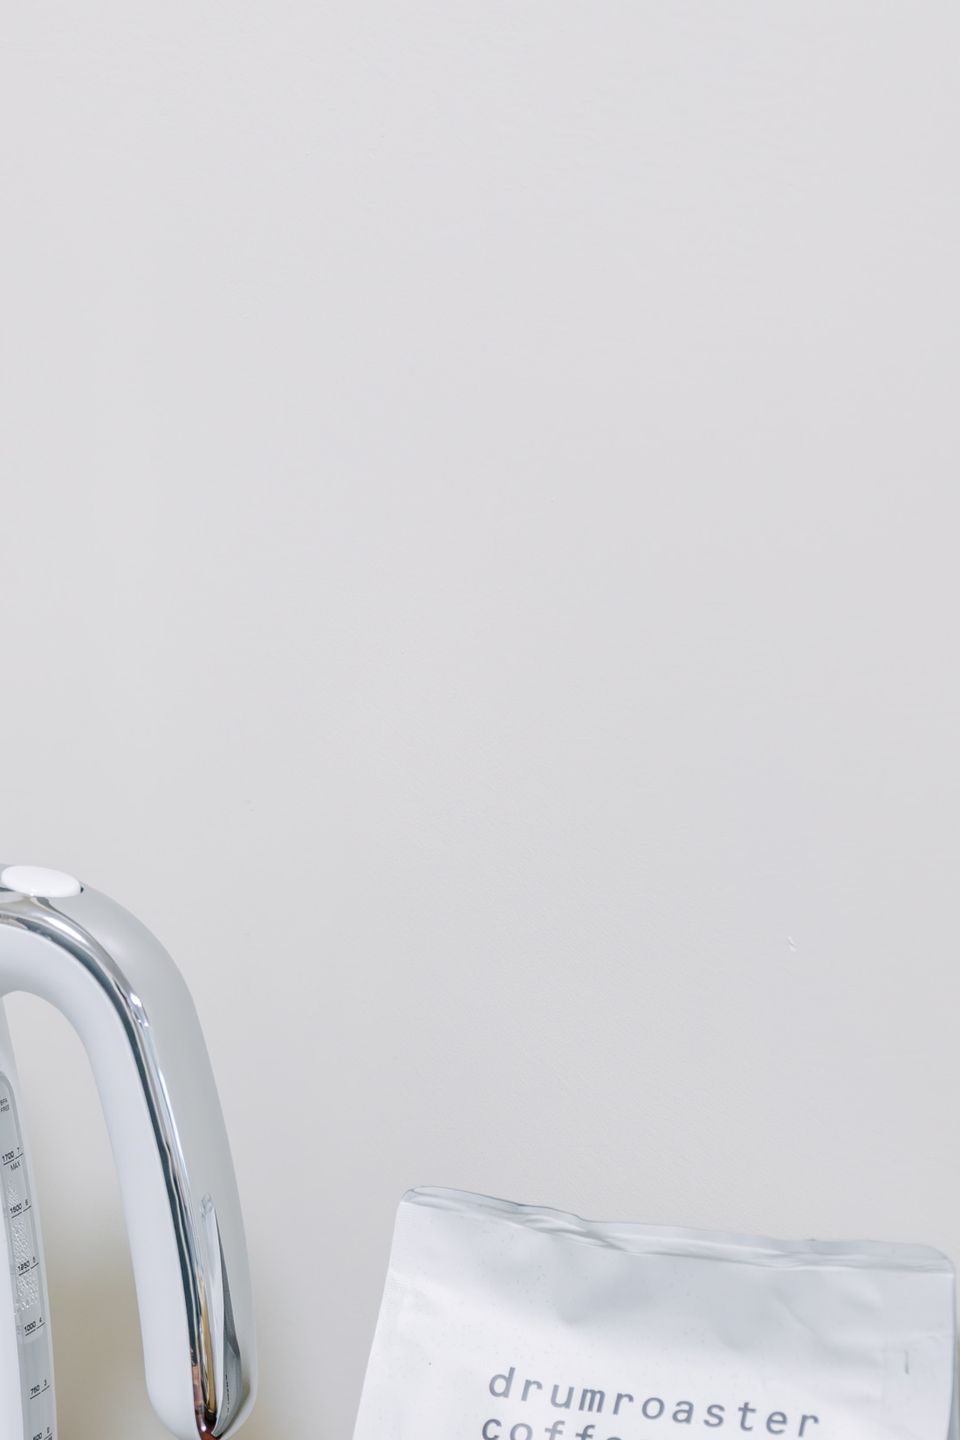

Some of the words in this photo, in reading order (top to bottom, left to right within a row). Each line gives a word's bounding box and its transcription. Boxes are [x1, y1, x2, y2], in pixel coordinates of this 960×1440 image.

[2, 1151, 14, 1162] 1700
[24, 1321, 36, 1332] 1000
[488, 1367, 820, 1437] drumroaster
